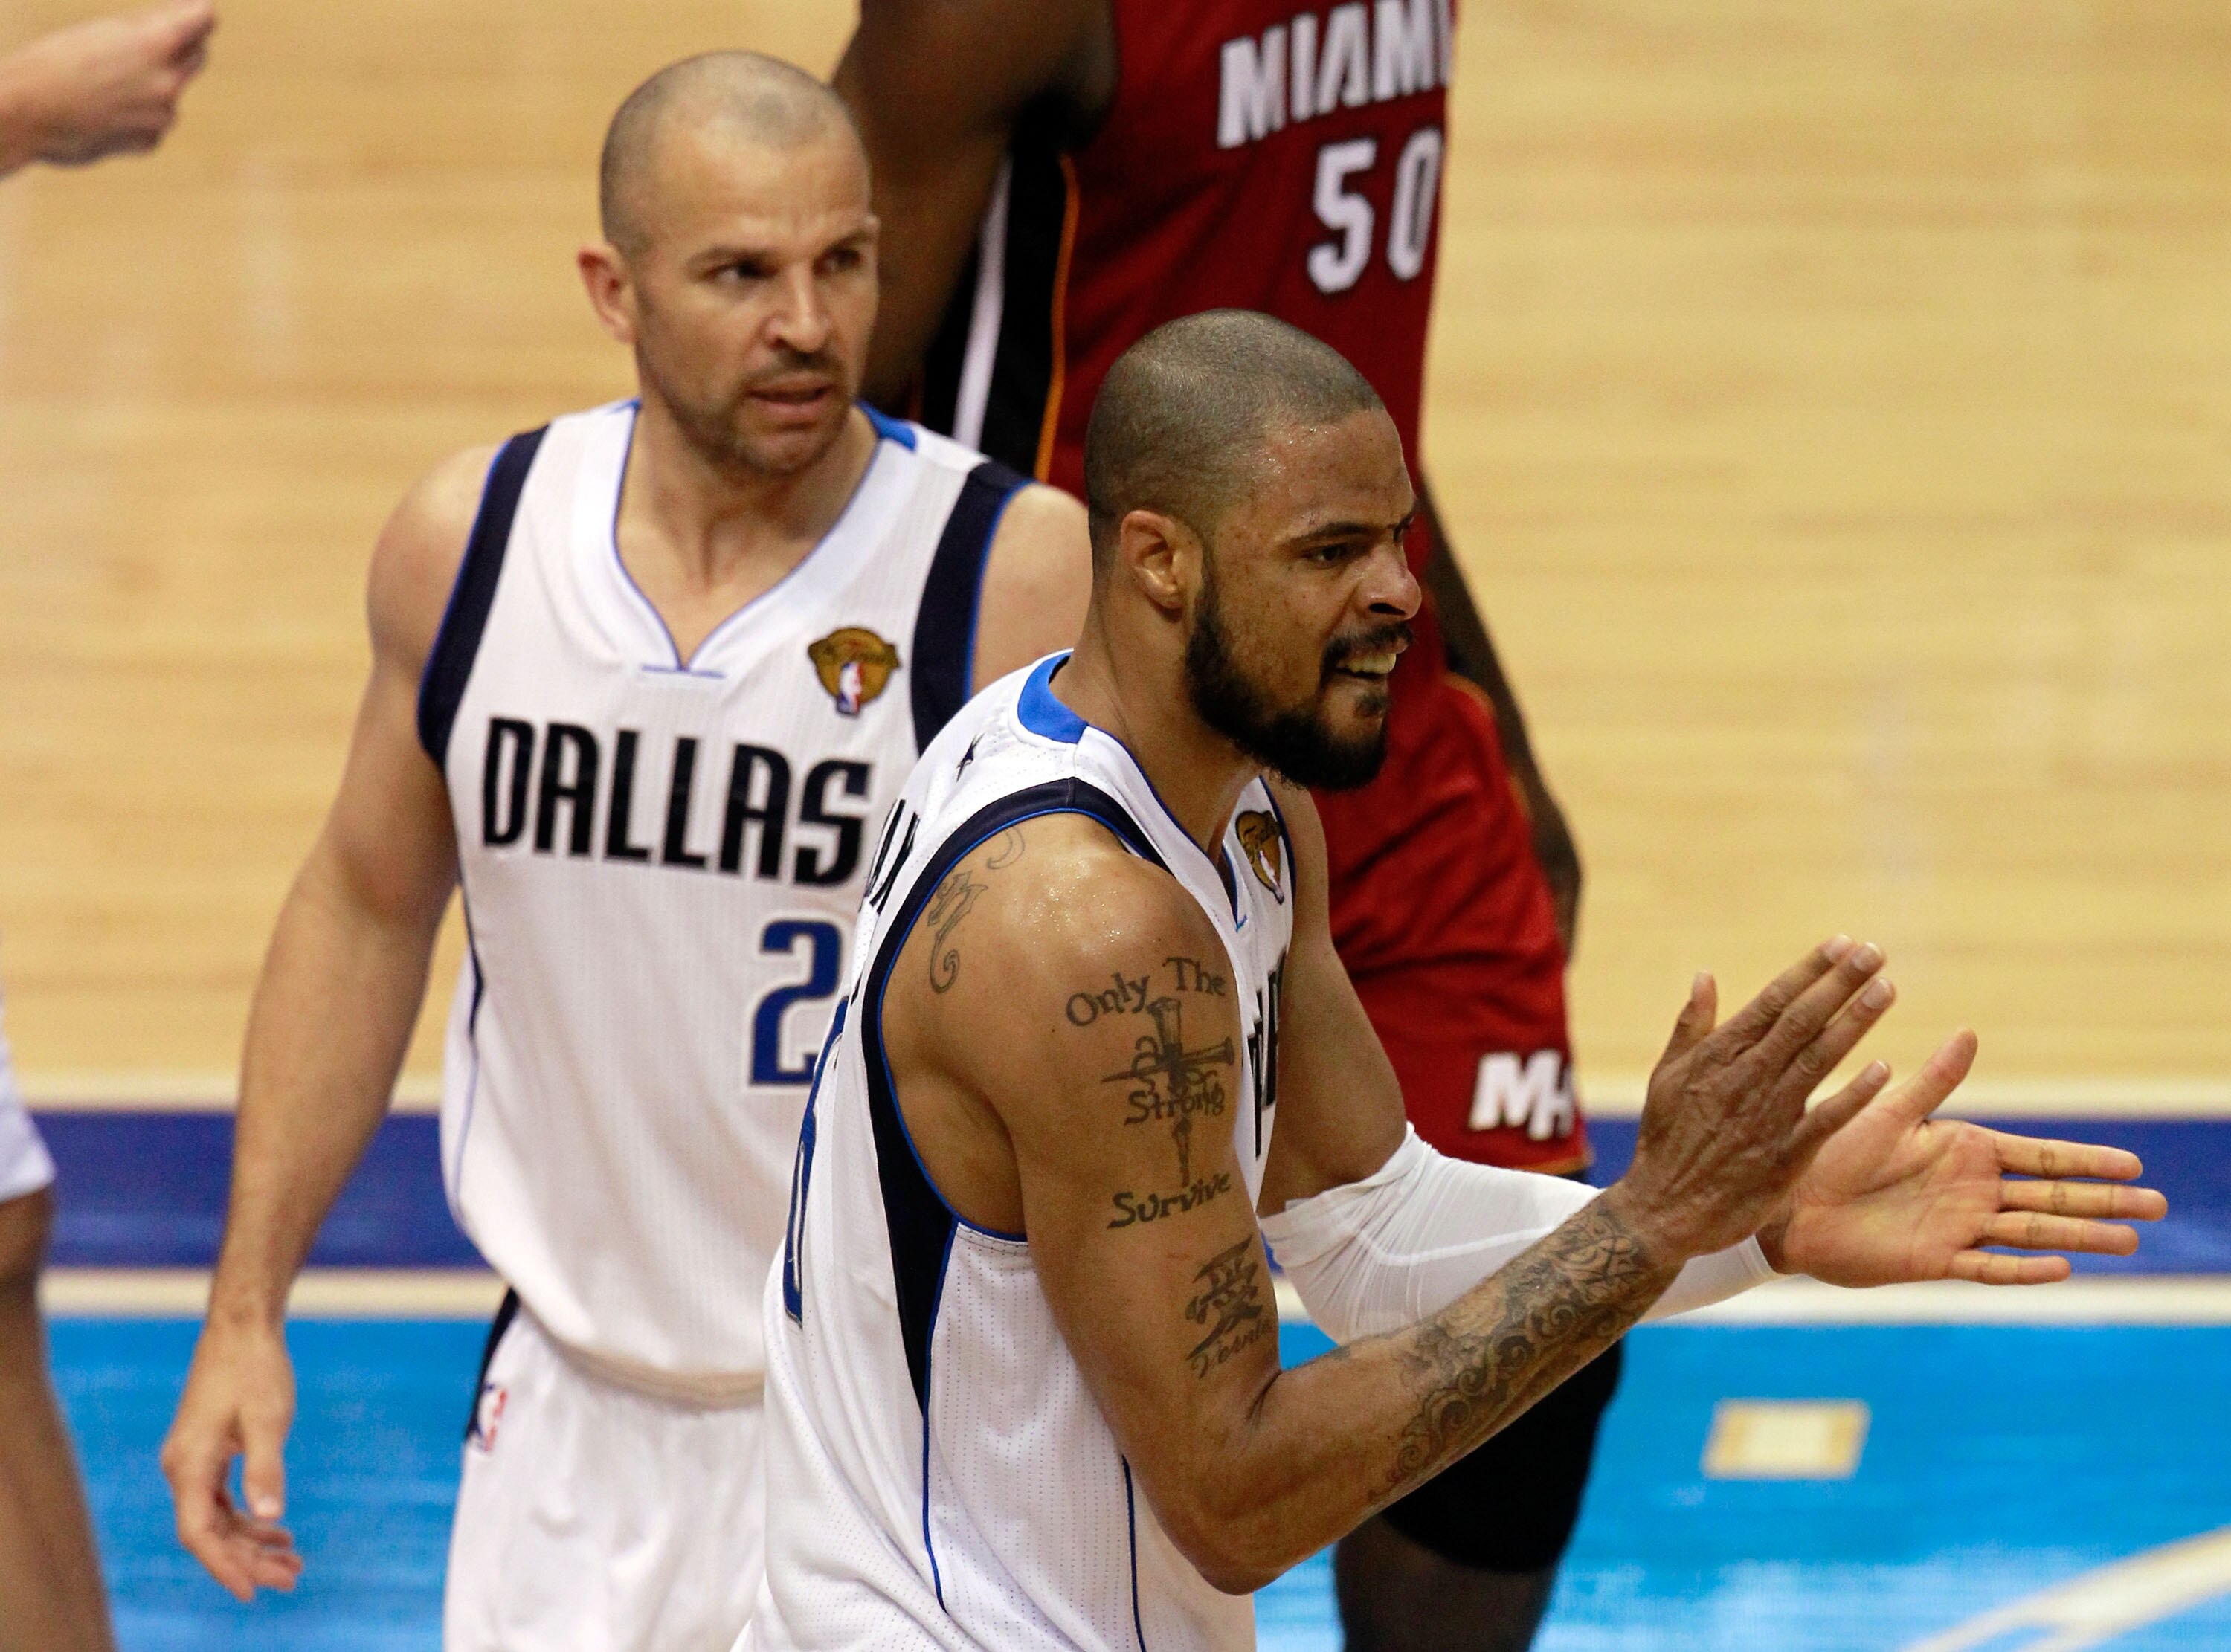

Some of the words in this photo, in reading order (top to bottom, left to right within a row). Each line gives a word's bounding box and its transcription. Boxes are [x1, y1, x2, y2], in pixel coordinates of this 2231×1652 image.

[1217, 0, 1452, 148] MIAMI
[1307, 126, 1443, 294] 50
[482, 716, 872, 888] DALLAS
[747, 916, 843, 1088] 2
[1066, 972, 1150, 1027] Only
[1161, 956, 1227, 997] The
[1124, 1082, 1225, 1126] Strong
[1107, 1173, 1232, 1229] Survive
